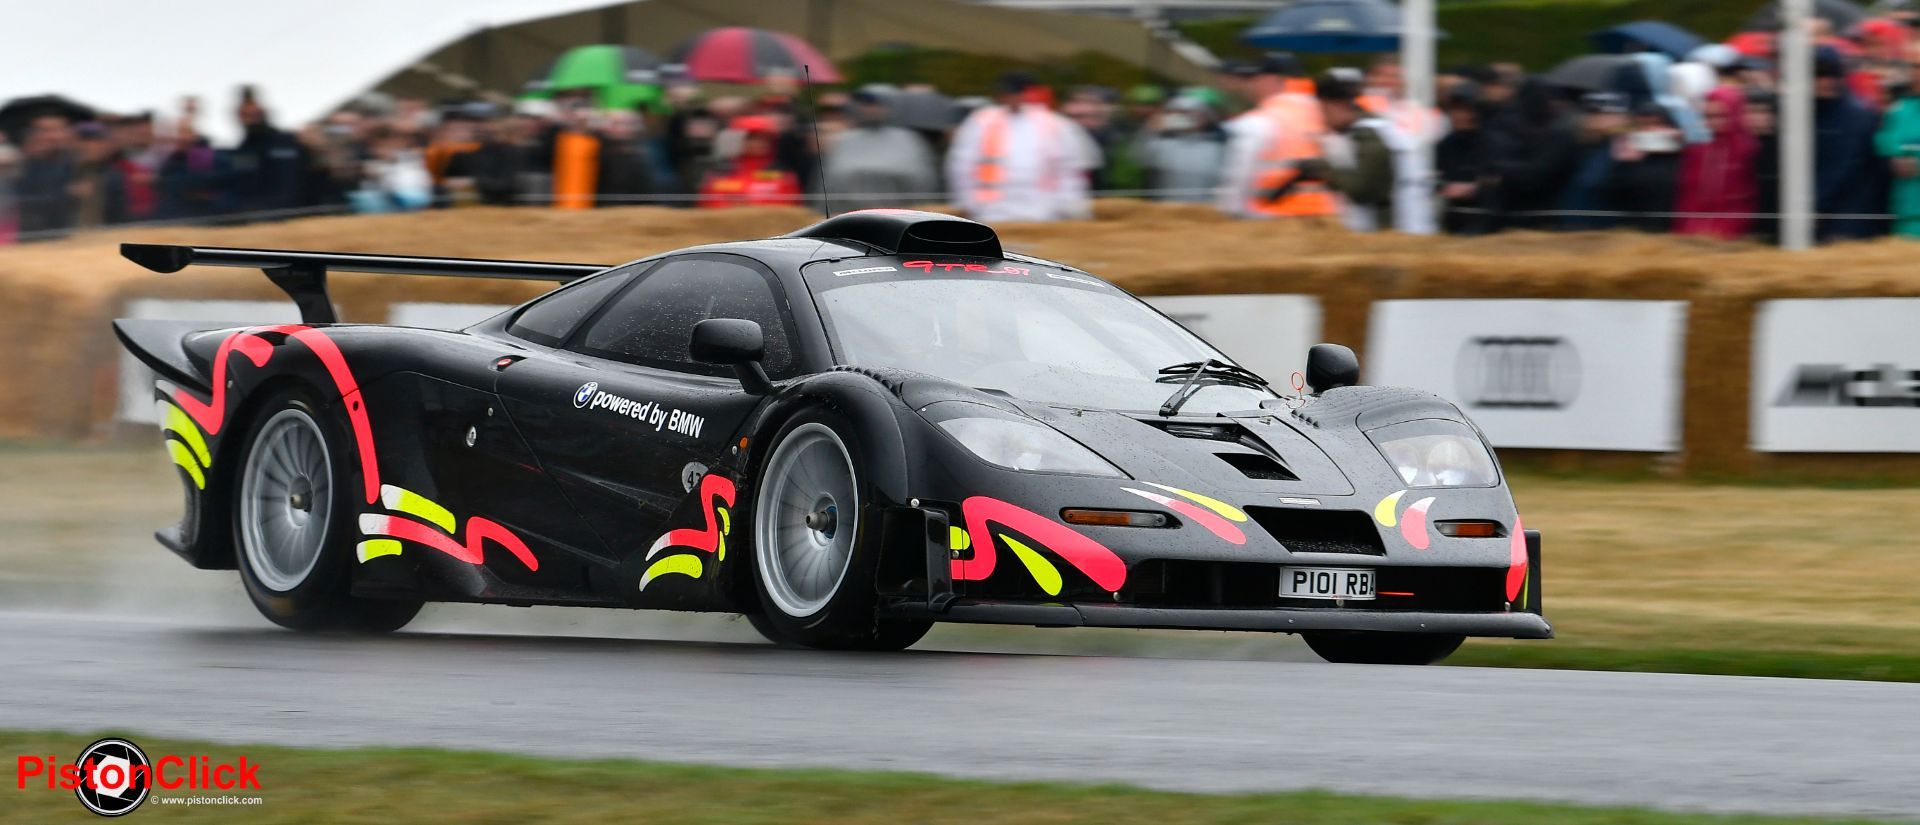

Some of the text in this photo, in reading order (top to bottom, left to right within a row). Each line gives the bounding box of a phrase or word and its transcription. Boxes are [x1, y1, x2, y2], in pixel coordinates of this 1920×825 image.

[589, 390, 705, 438] powered by BMW
[1293, 571, 1337, 595] P101
